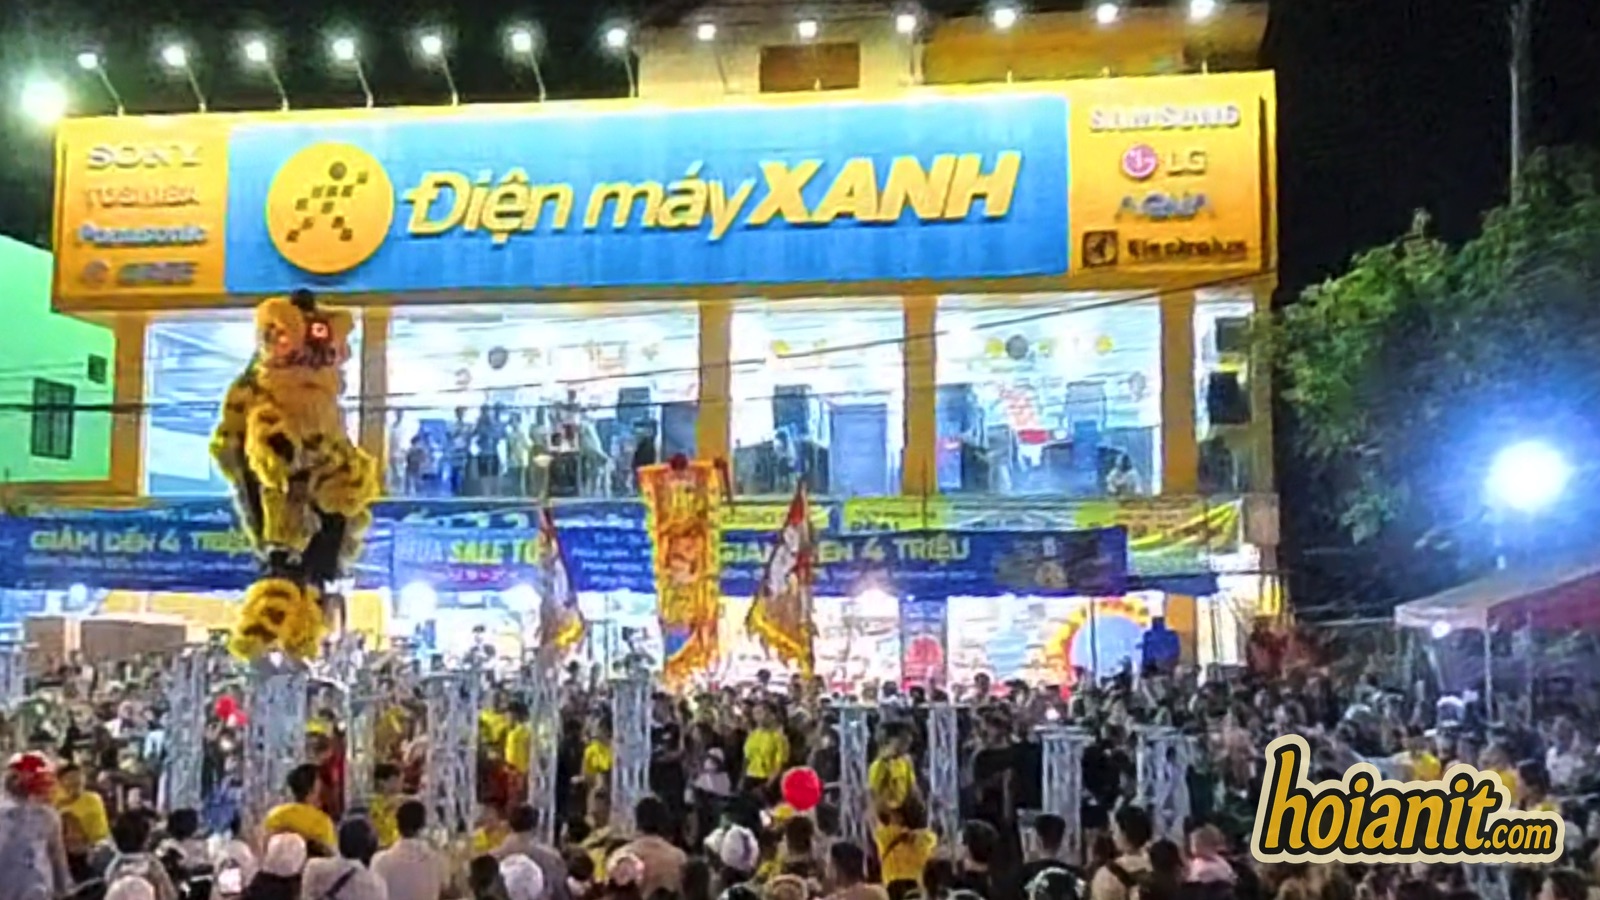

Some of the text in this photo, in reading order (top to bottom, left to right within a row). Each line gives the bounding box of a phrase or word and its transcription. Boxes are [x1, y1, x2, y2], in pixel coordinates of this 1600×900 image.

[1166, 151, 1207, 175] LG
[402, 166, 573, 243] Điện
[158, 526, 181, 552] 4
[861, 536, 886, 561] 4
